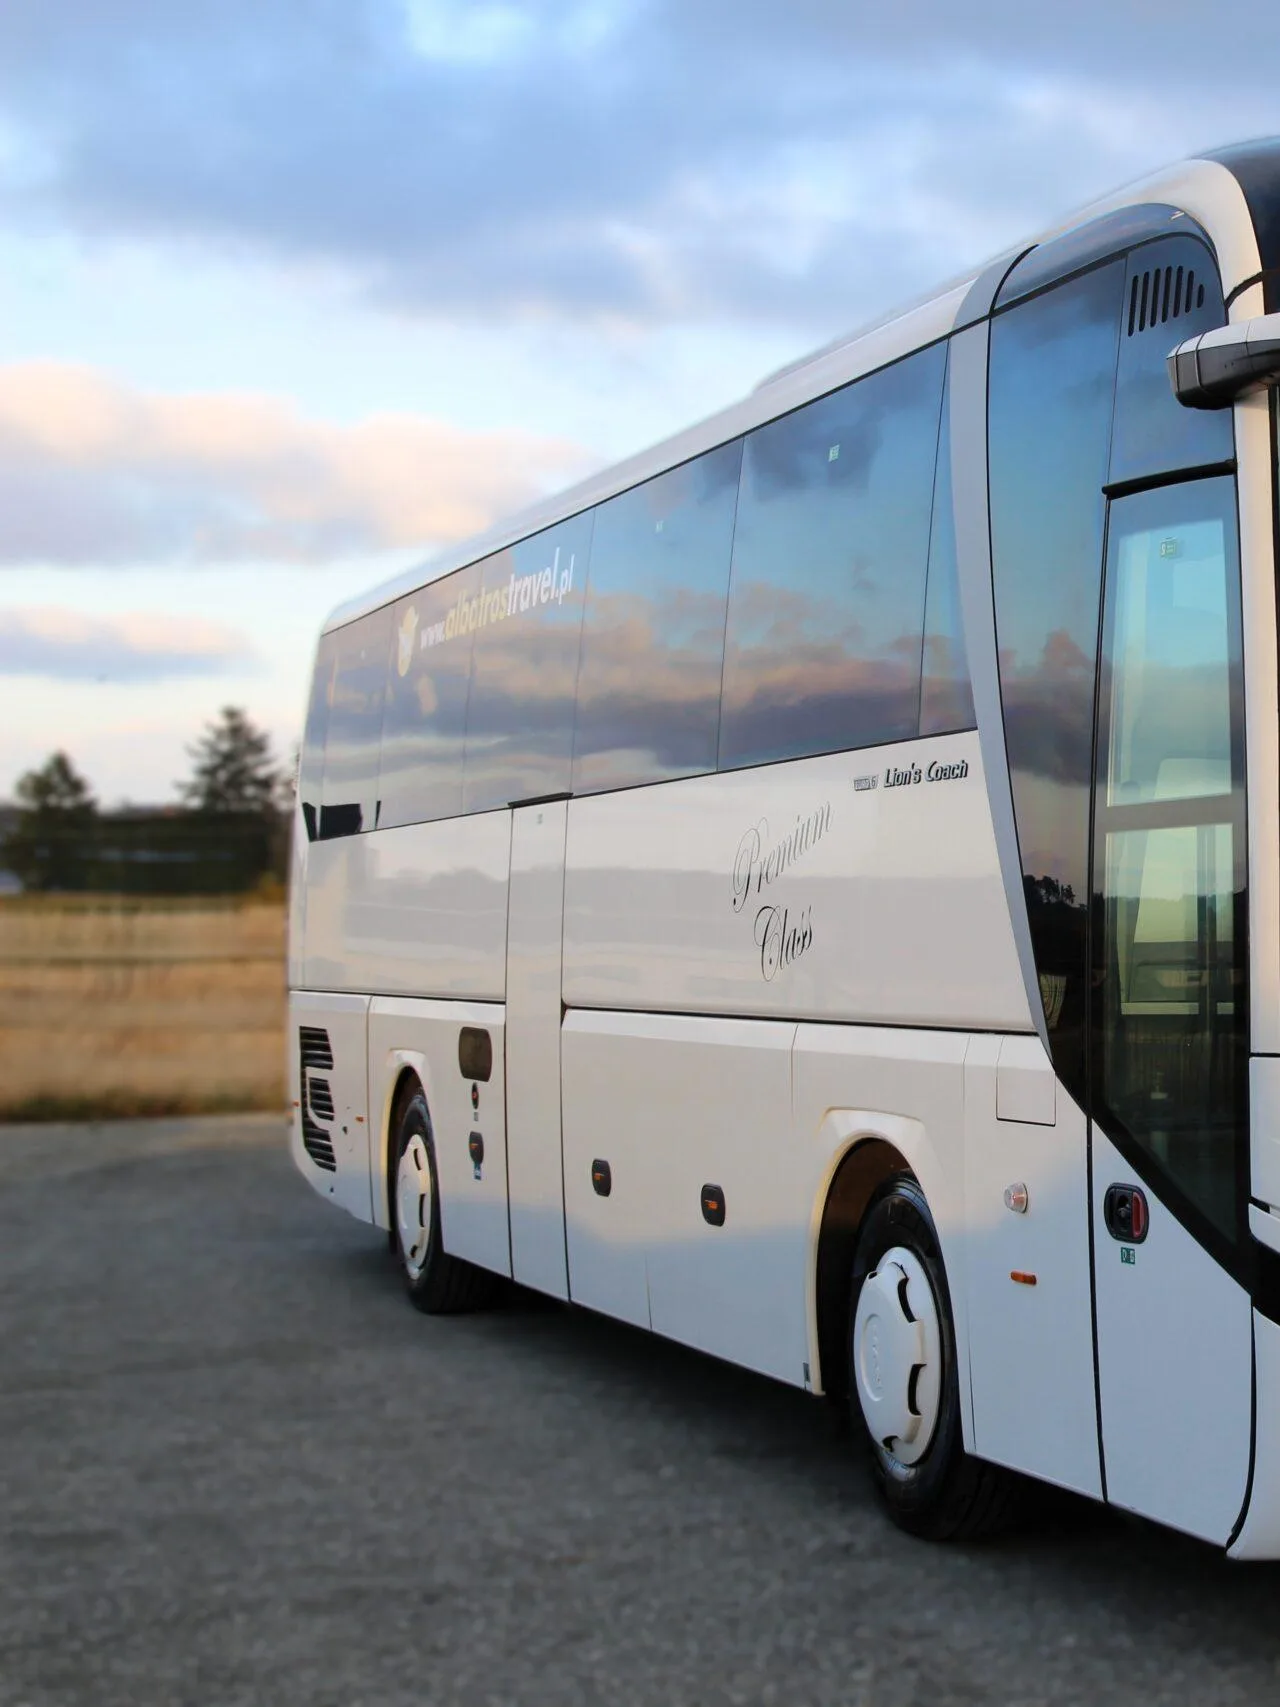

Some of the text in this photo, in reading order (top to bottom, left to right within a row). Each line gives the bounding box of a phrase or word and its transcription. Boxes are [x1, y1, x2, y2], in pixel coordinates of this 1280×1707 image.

[884, 762, 922, 788] Lion's
[925, 759, 969, 782] Coach
[732, 800, 832, 914] Premium
[754, 905, 813, 982] Class
